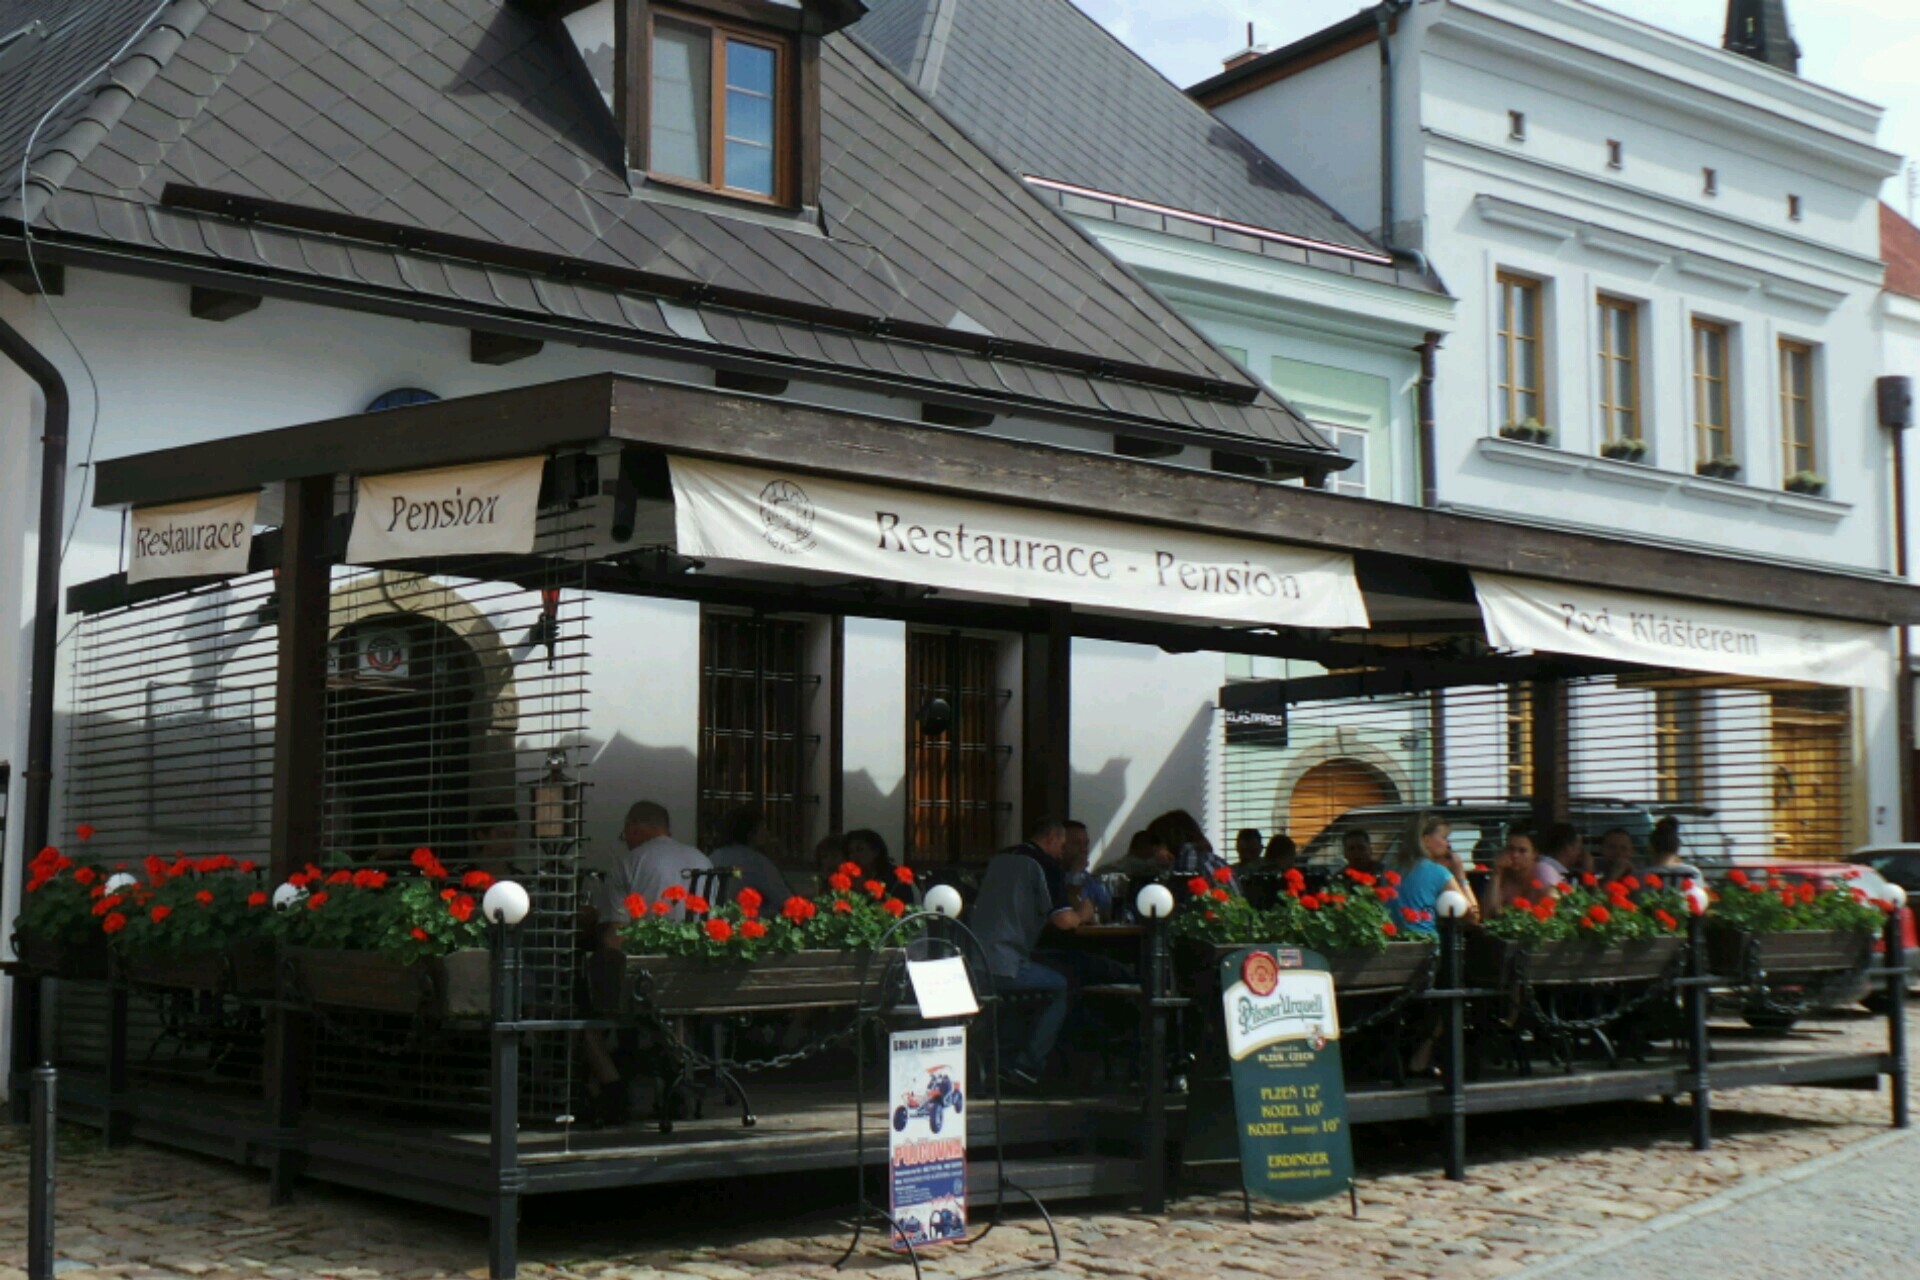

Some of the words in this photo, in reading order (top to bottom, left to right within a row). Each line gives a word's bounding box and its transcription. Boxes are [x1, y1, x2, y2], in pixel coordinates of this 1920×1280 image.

[387, 487, 502, 532] Pension
[135, 519, 245, 558] Restaurace
[875, 511, 1111, 580] Restaurace
[1154, 551, 1302, 600] Pension
[1561, 603, 1616, 637] Pod
[1629, 611, 1761, 656] Klášterem
[1237, 996, 1281, 1036] Pilsner
[1279, 994, 1324, 1022] Urquell
[1247, 1122, 1288, 1136] KOZEL
[1261, 1104, 1301, 1118] KOZEL
[1267, 1152, 1329, 1168] ERDINGER
